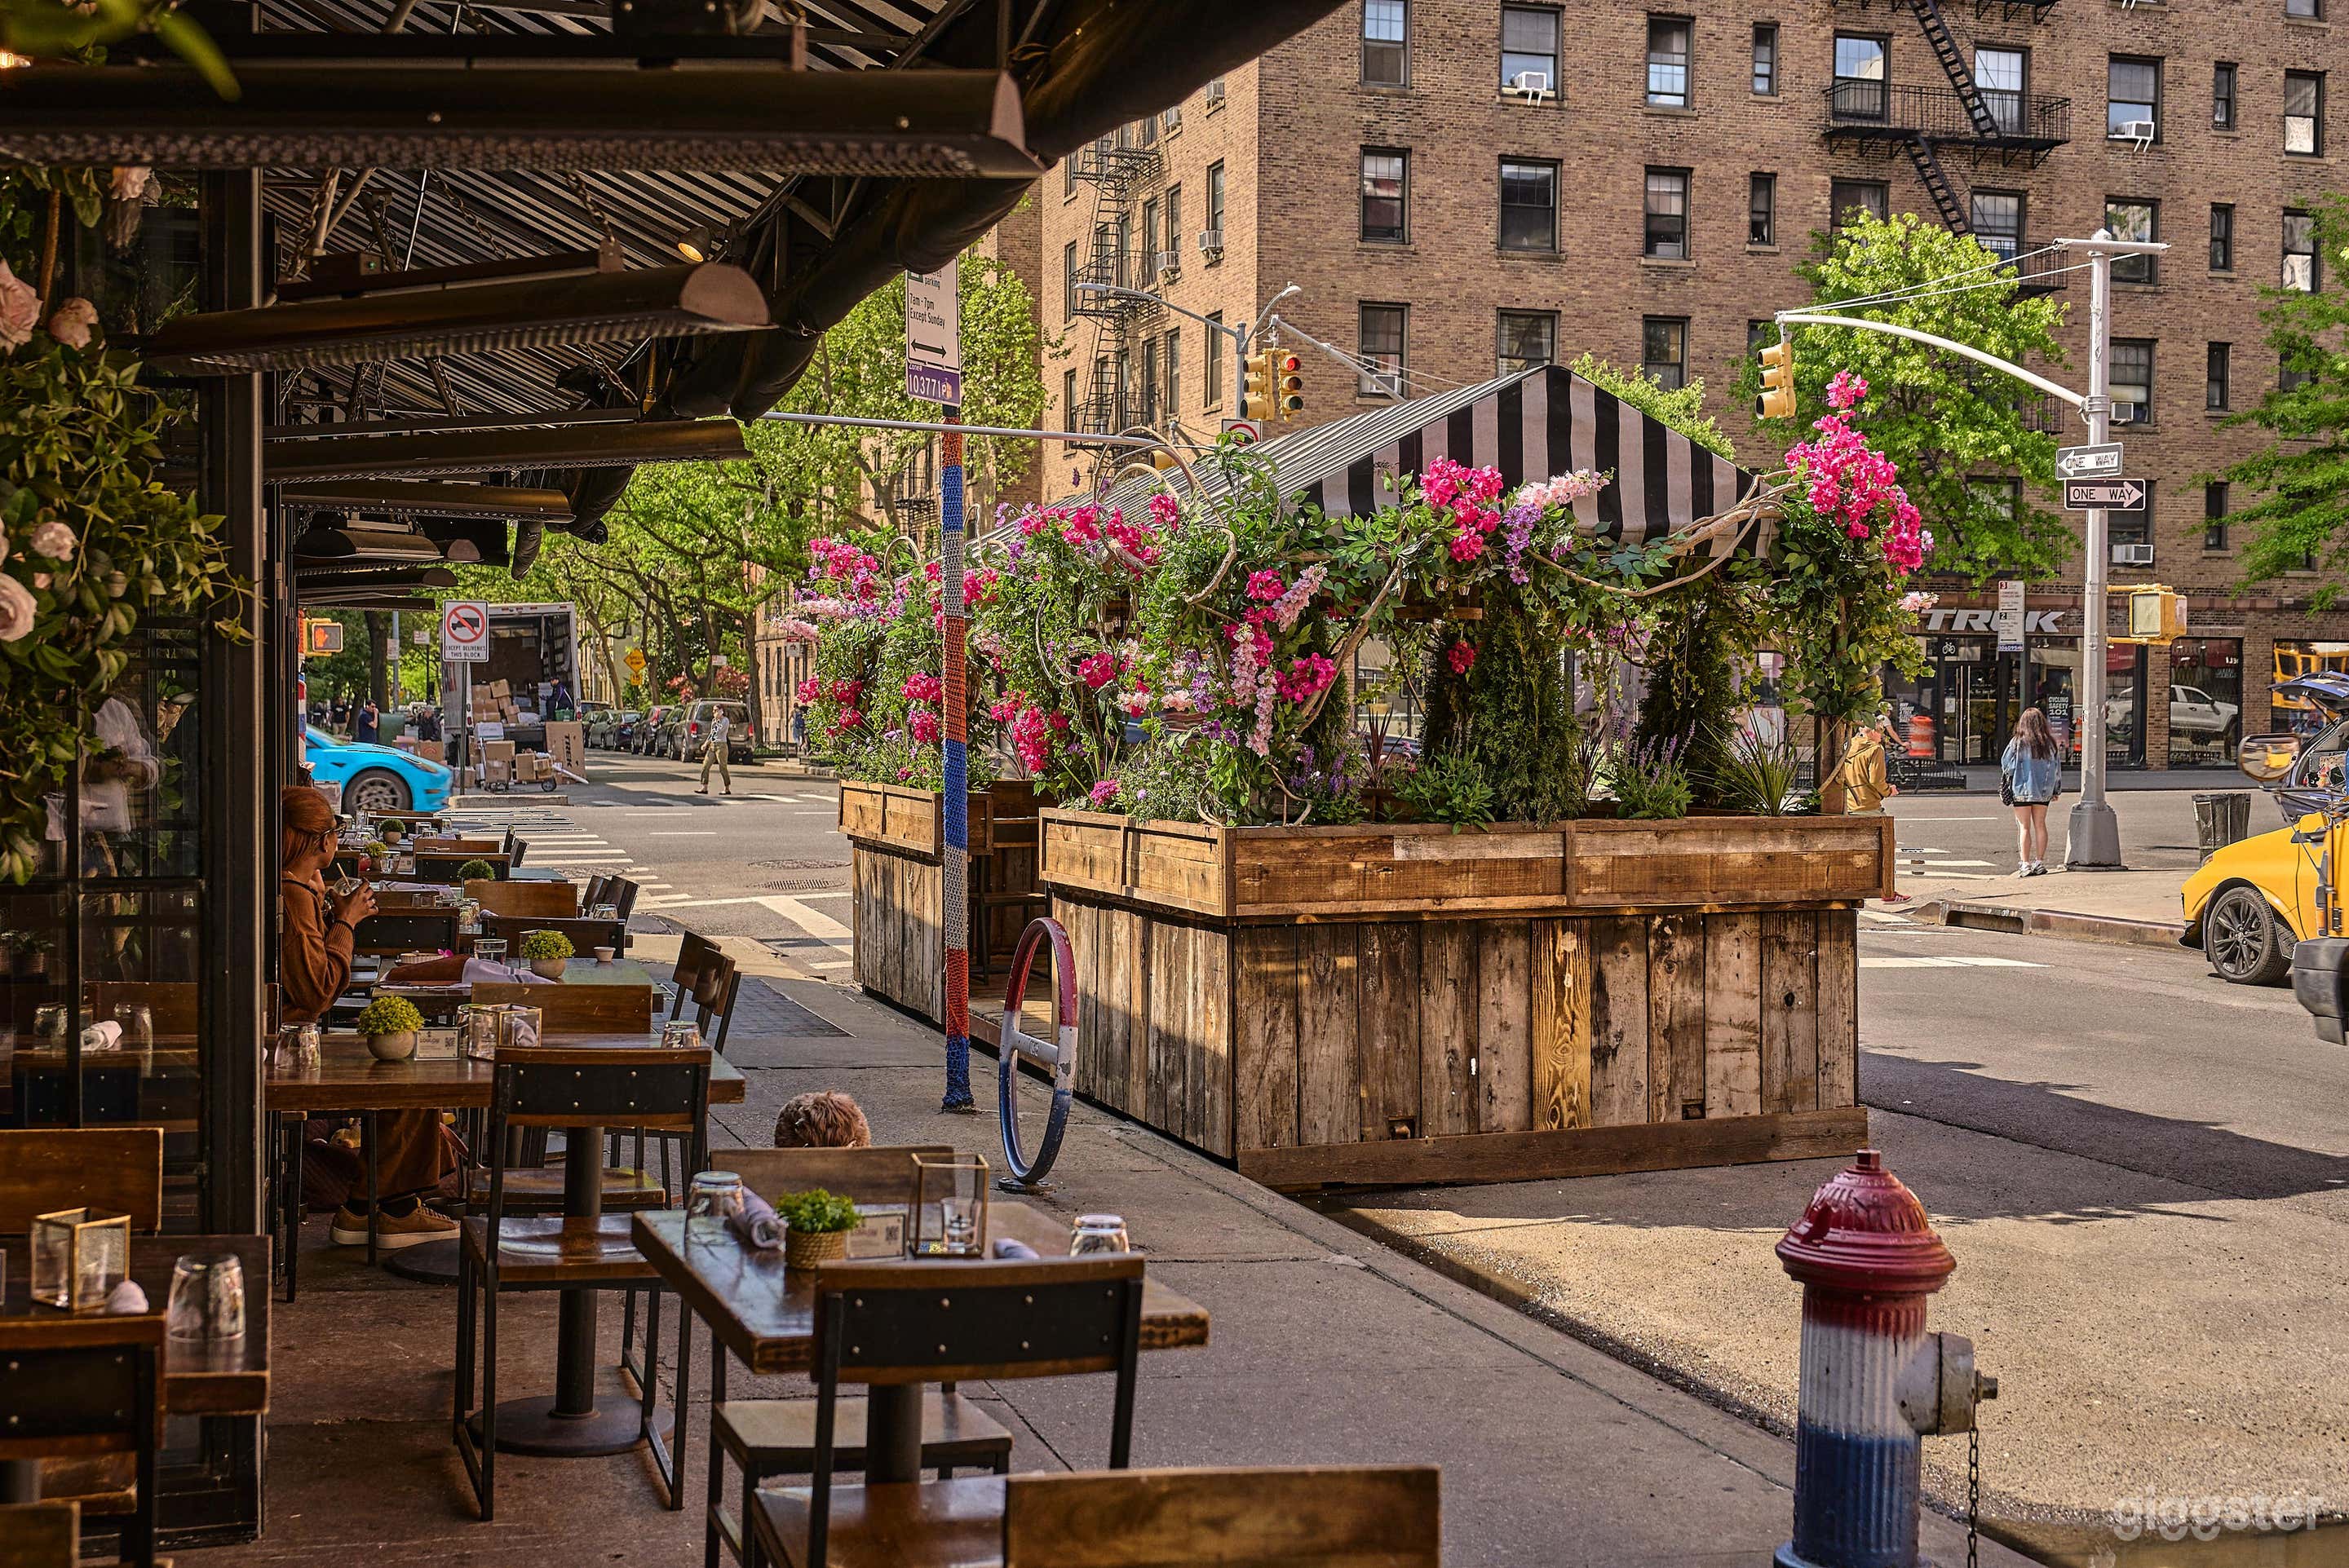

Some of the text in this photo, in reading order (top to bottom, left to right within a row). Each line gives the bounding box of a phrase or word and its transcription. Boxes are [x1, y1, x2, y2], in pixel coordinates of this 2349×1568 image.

[925, 277, 940, 290] parking
[910, 307, 946, 330] Except Sunday
[909, 374, 940, 399] 103771
[2066, 454, 2117, 469] ONE WAY
[2073, 488, 2134, 500] ONE WAY
[1921, 608, 2065, 633] TRK
